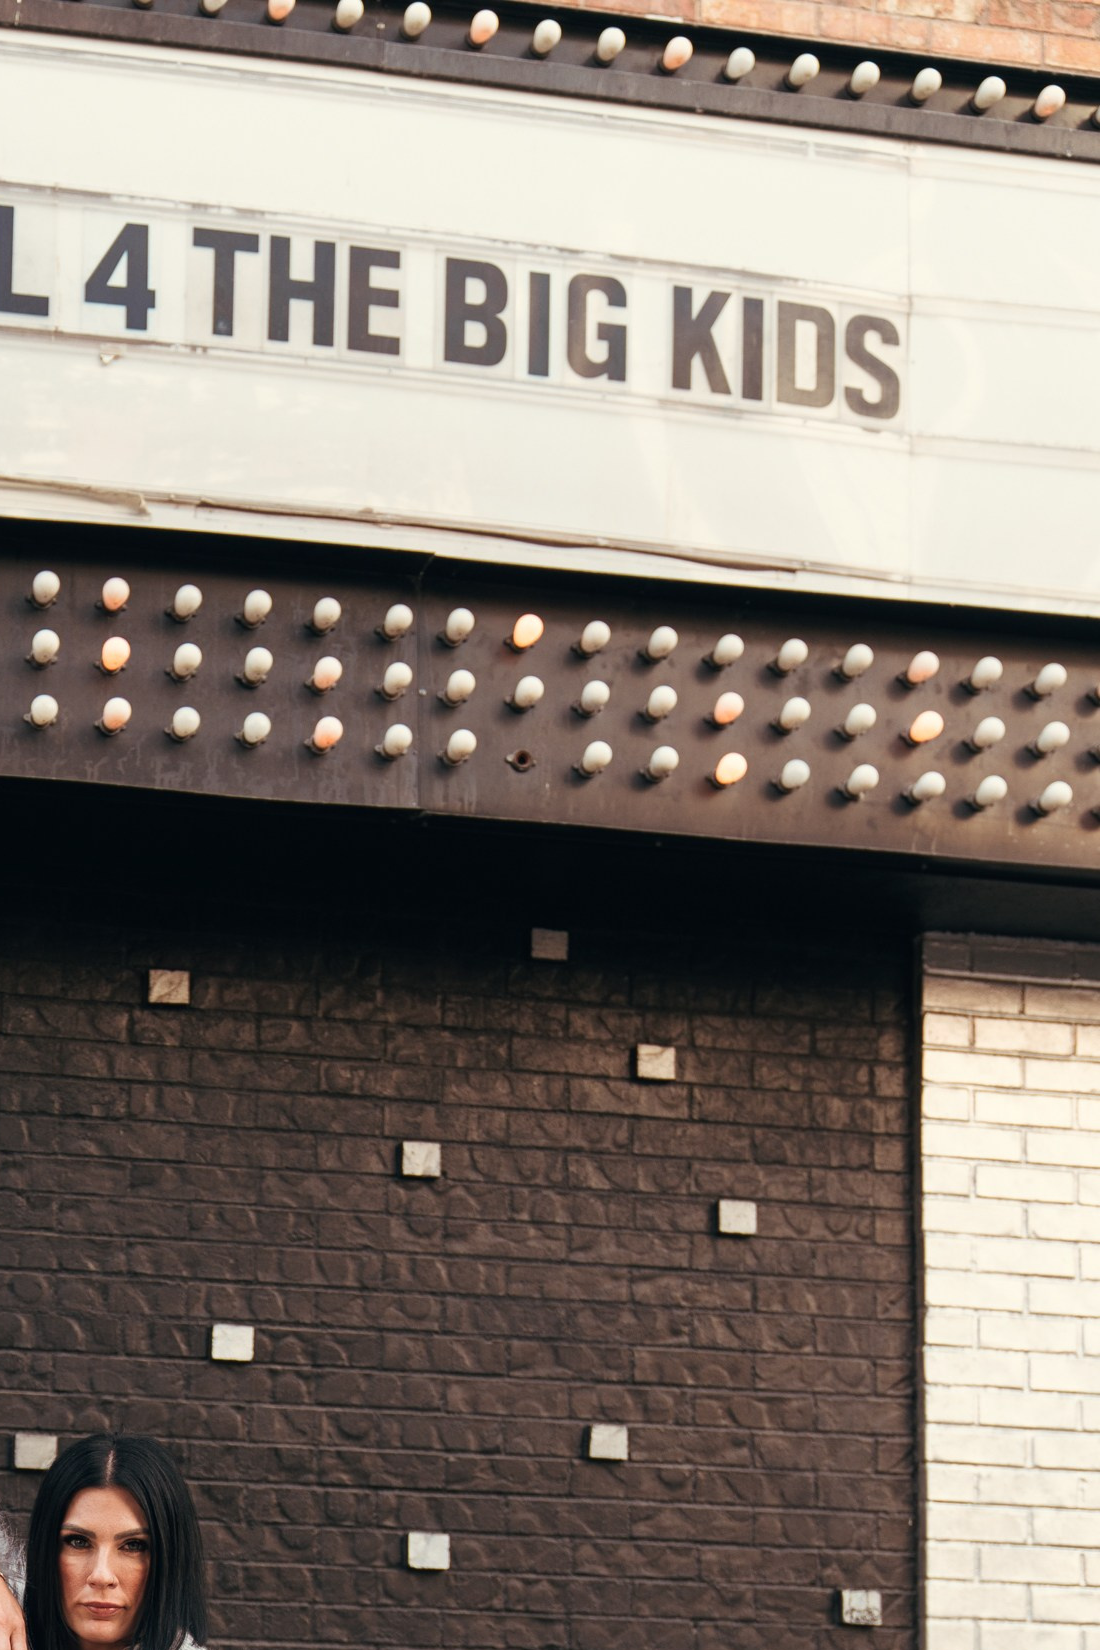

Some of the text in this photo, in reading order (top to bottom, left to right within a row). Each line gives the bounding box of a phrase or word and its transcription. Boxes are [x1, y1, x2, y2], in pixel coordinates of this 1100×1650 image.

[84, 223, 156, 331] 4
[191, 226, 401, 356] THE
[443, 256, 628, 382] BIG
[672, 285, 901, 420] KIDS
